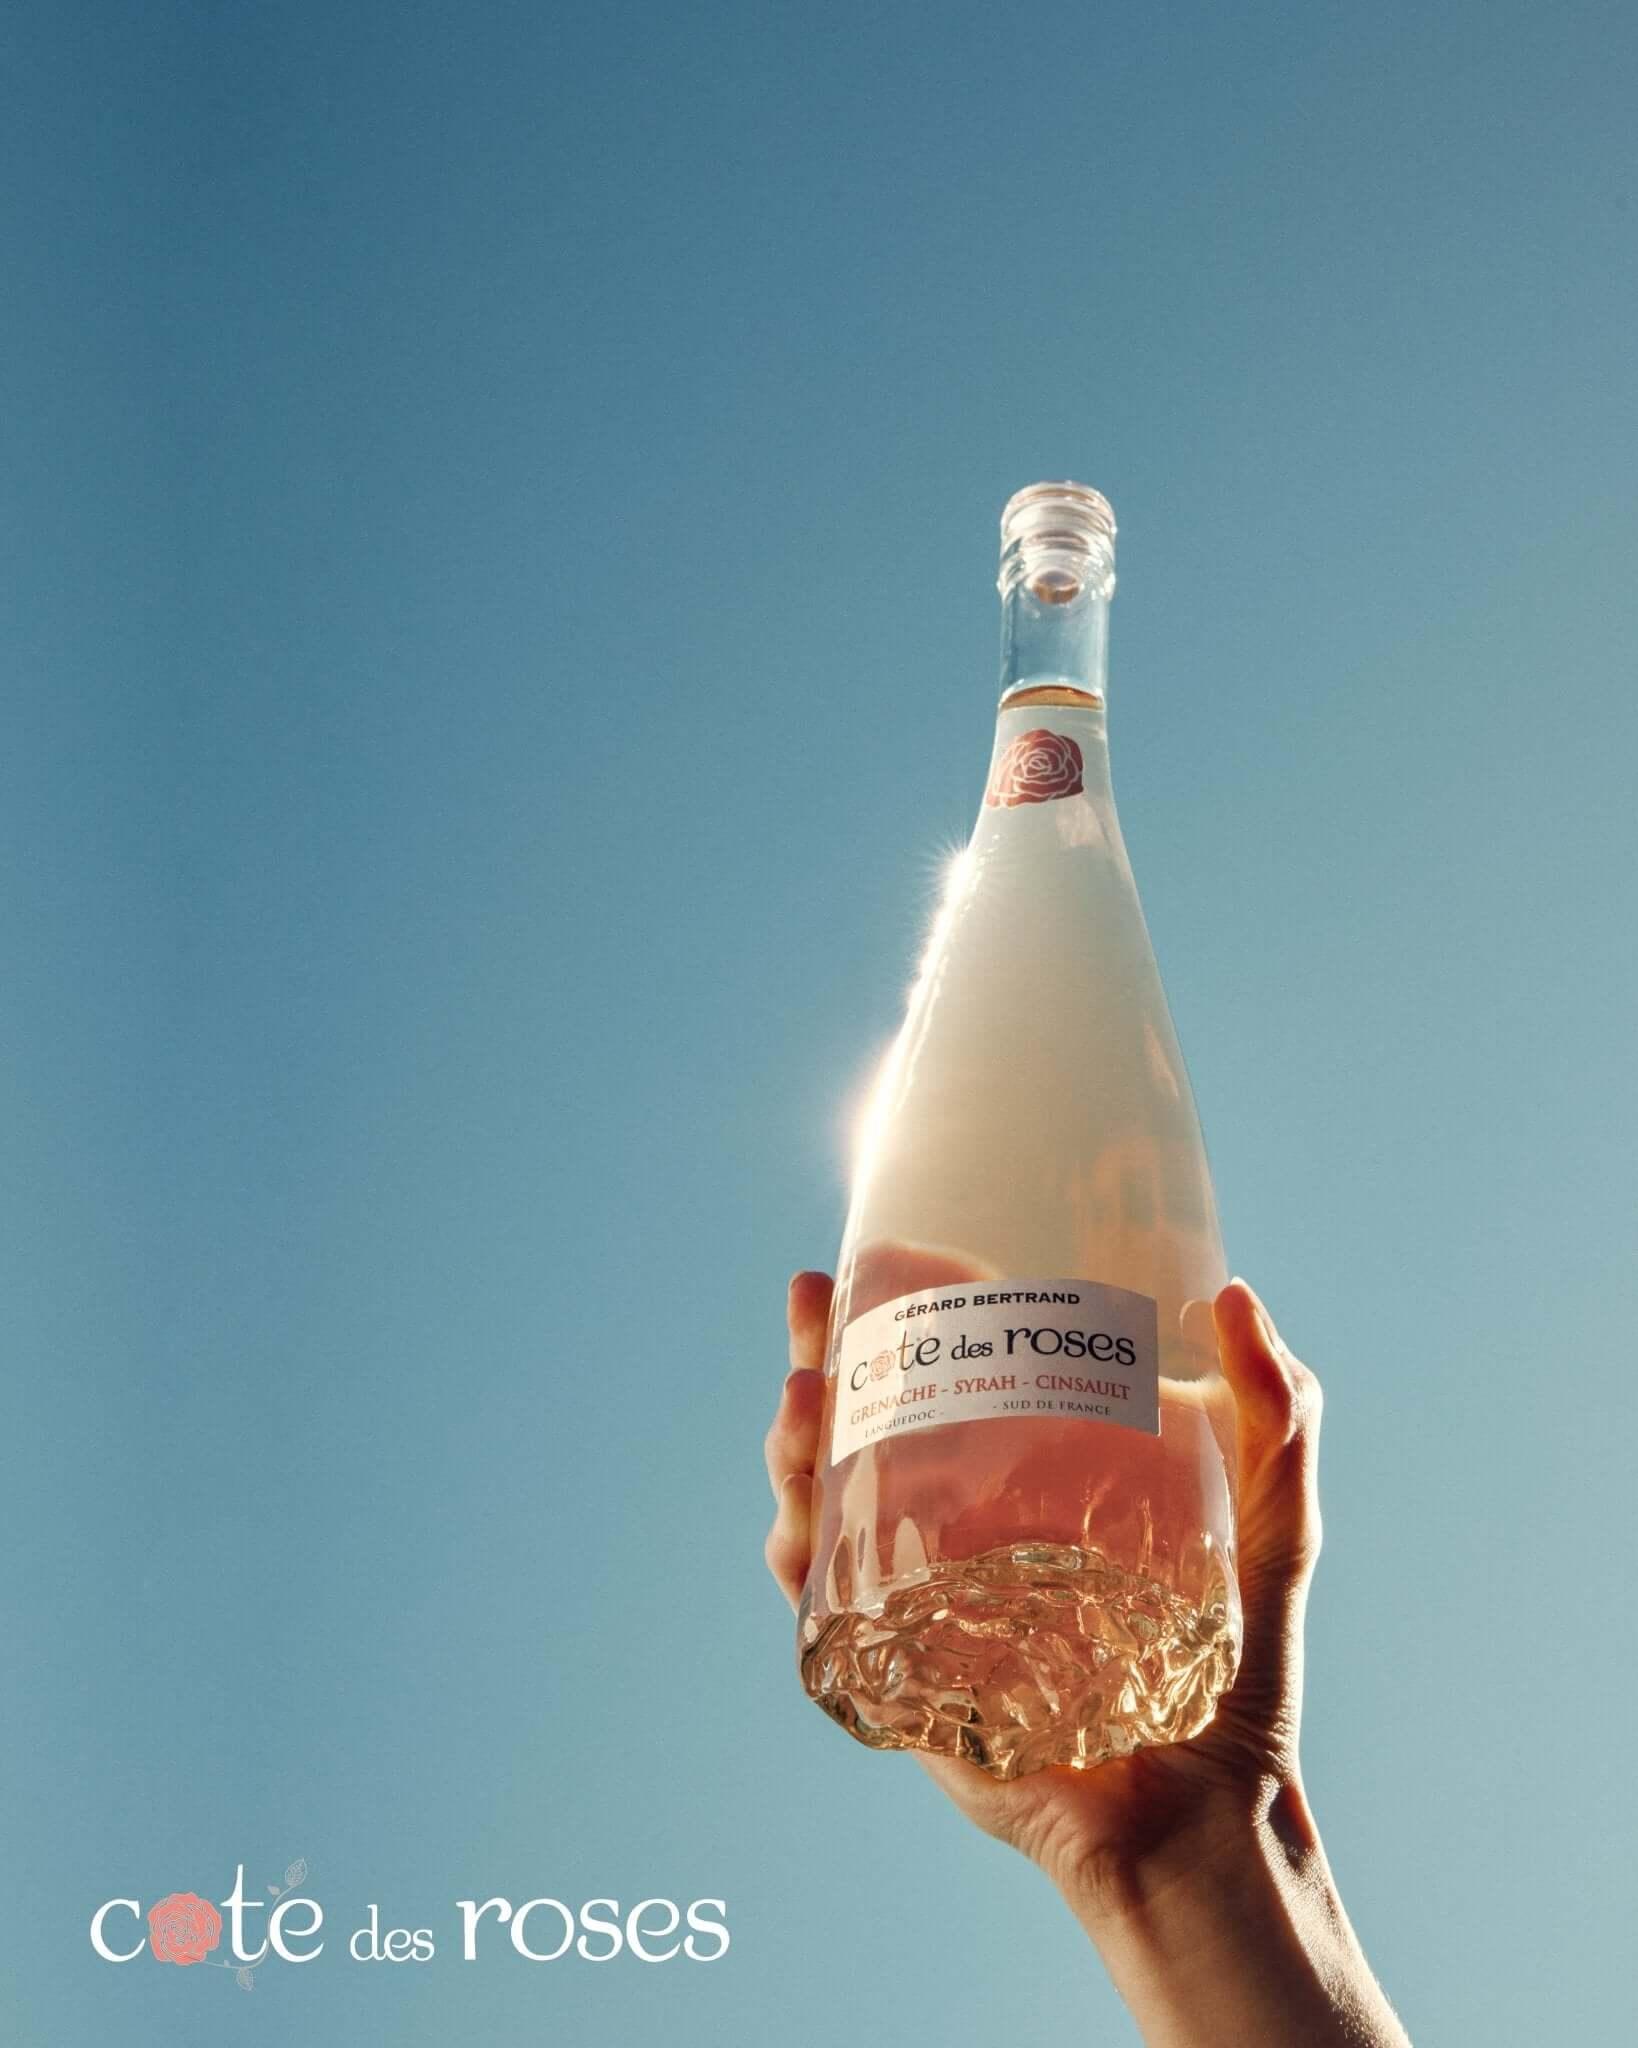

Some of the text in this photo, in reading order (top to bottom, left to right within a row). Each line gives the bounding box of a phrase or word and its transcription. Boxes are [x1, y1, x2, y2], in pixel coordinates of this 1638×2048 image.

[894, 1292, 1081, 1321] GÉRARD BERTRAND
[951, 1334, 993, 1360] des
[1003, 1327, 1137, 1367] roses
[850, 1383, 937, 1426] GRENACHE
[953, 1375, 1016, 1395] SYRAH
[1035, 1374, 1131, 1401] CINSAULT
[1002, 1400, 1031, 1410] SUD
[1036, 1400, 1055, 1410] DE
[1059, 1400, 1113, 1416] FRANCE
